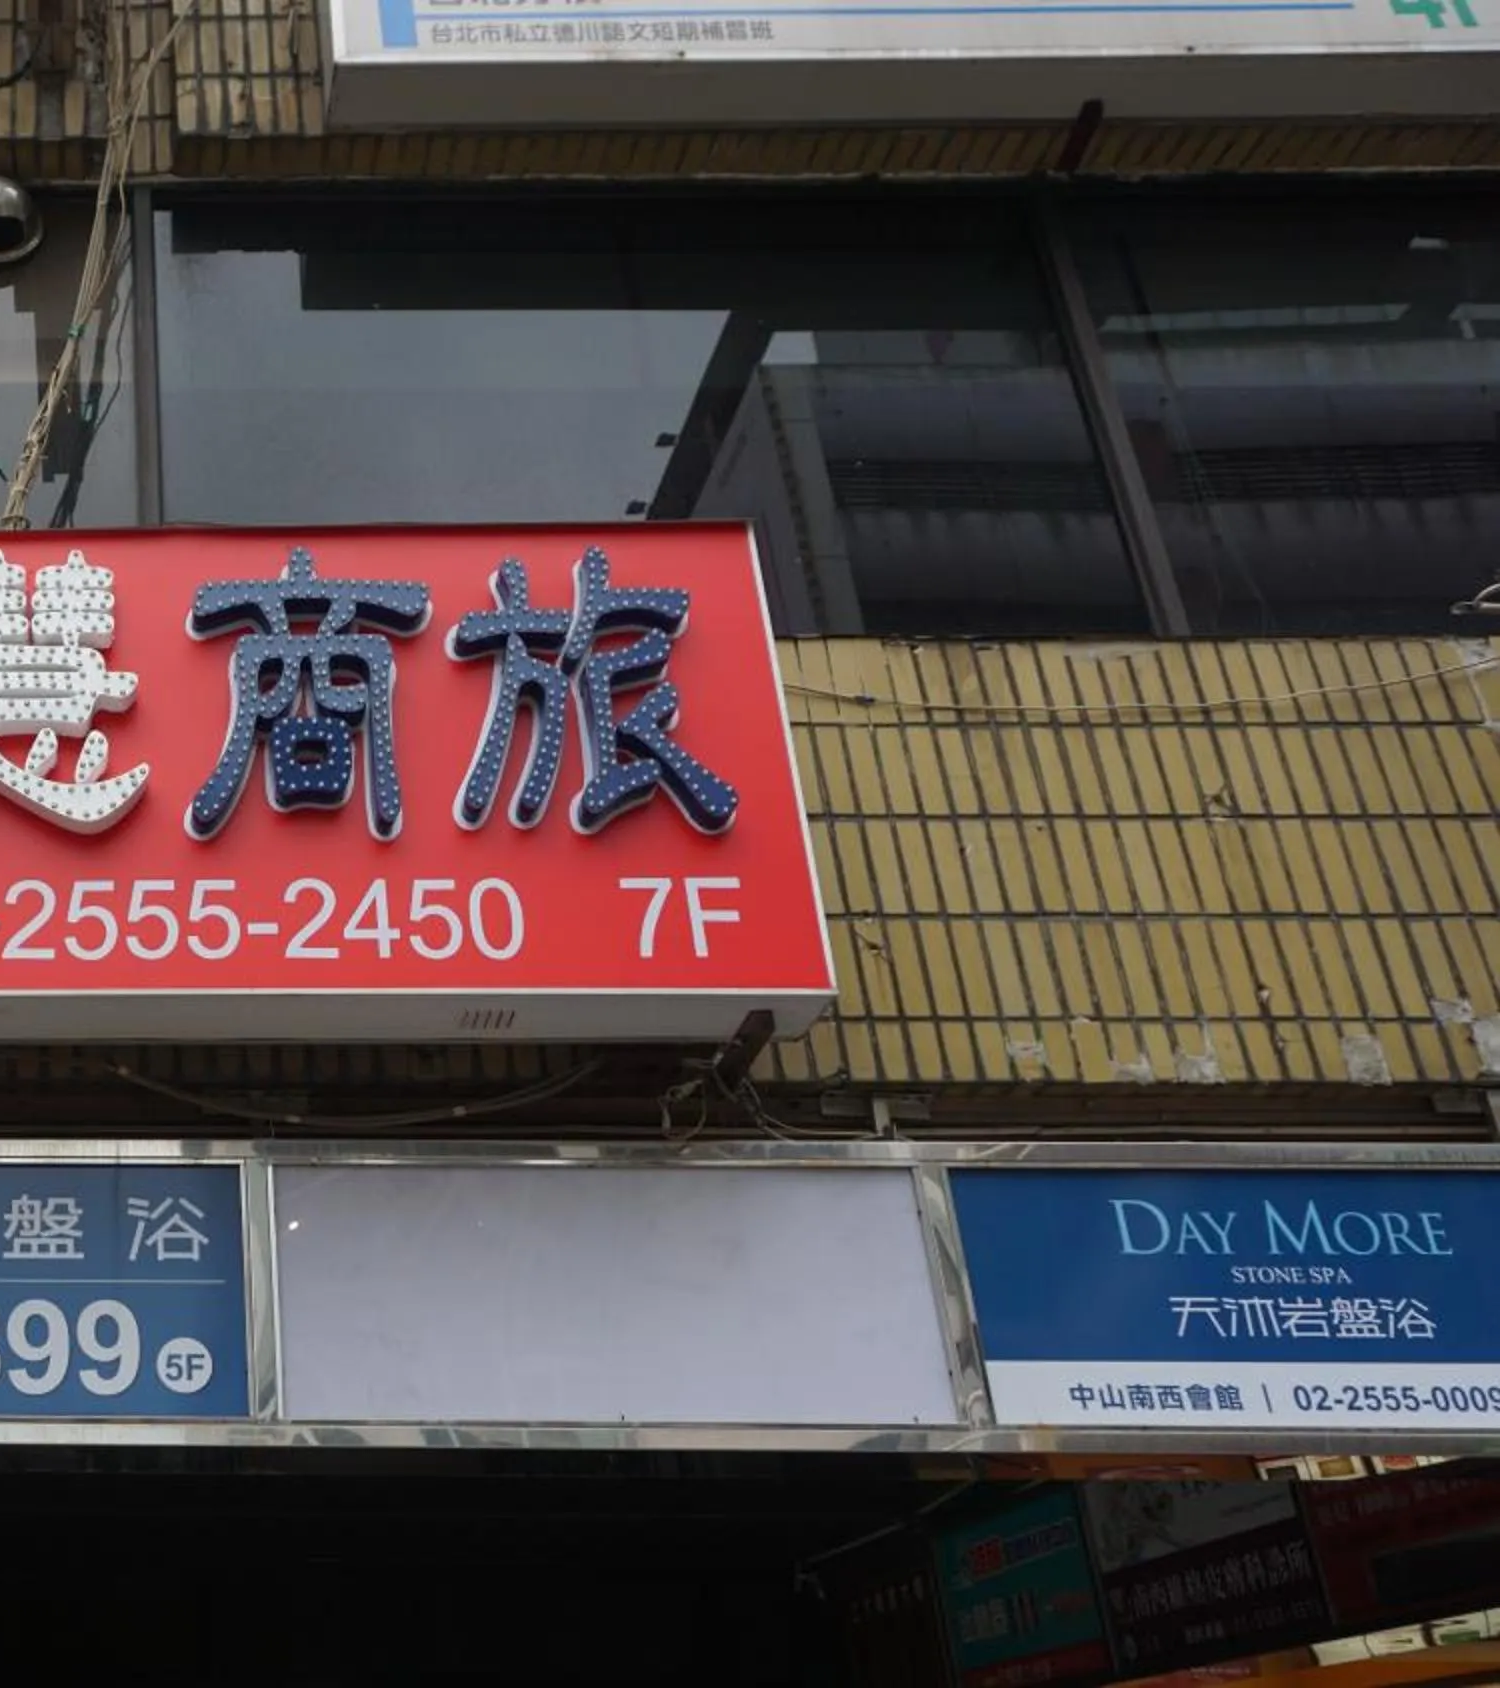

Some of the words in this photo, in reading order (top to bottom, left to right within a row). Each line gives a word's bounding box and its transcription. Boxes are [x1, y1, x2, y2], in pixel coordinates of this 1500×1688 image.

[619, 877, 741, 959] 7F
[1109, 1199, 1238, 1256] DAY
[1264, 1199, 1453, 1256] MORE
[1230, 1266, 1306, 1285] STONE
[1308, 1266, 1353, 1285] SPA
[164, 1353, 205, 1382] 5F
[1069, 1383, 1246, 1412] 中山南西會館
